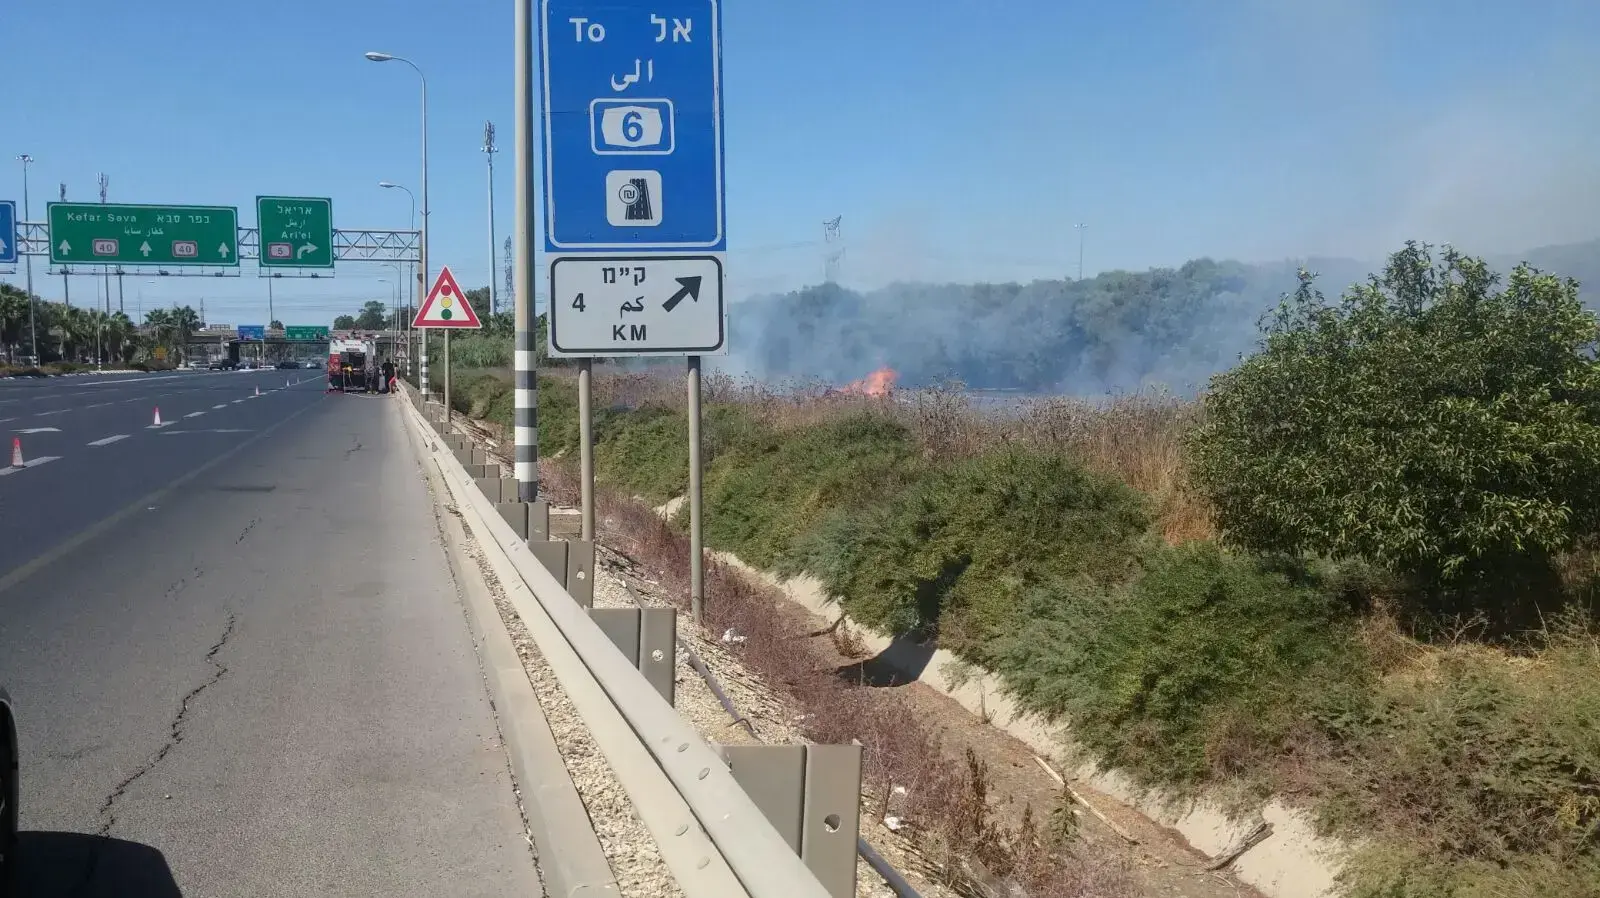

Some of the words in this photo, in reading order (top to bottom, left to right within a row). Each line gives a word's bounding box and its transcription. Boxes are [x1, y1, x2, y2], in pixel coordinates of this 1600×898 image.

[569, 17, 606, 43] To
[650, 13, 692, 43] אל
[622, 111, 644, 142] 6
[277, 205, 312, 215] אריאל
[67, 212, 101, 222] Kefar
[107, 213, 137, 223] Sava
[156, 214, 180, 223] סבא
[188, 214, 211, 224] כפר
[281, 230, 311, 240] Ari'el
[99, 244, 113, 253] 40
[178, 245, 192, 254] 40
[277, 247, 283, 255] 5
[571, 293, 587, 313] 4
[619, 295, 645, 319] كم
[612, 324, 647, 342] KM
